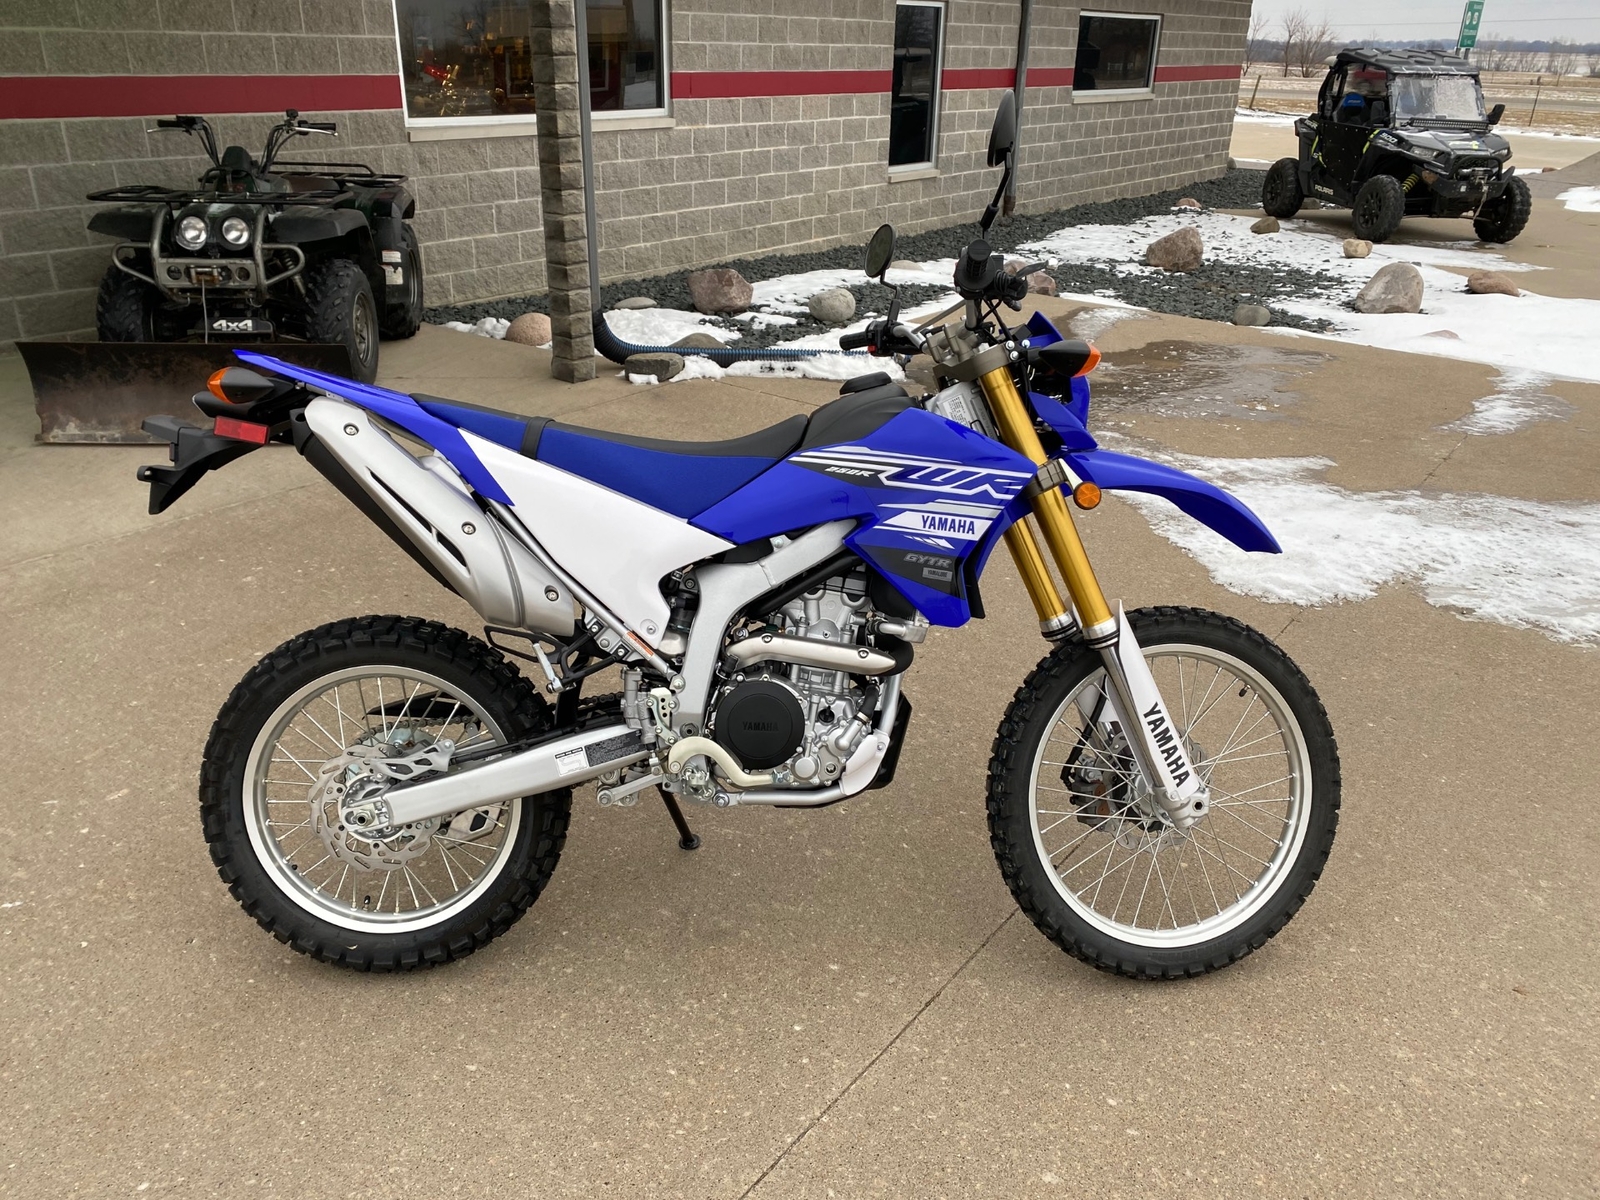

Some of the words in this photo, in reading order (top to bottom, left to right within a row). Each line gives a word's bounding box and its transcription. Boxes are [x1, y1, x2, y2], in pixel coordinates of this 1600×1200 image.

[1379, 132, 1398, 144] 900
[1314, 184, 1334, 196] POLARIS
[212, 319, 253, 331] 4x4
[921, 515, 975, 535] YAMAHA
[903, 552, 952, 568] GYTR
[742, 721, 780, 732] YAMAHA
[1143, 701, 1191, 788] YAMAHA
